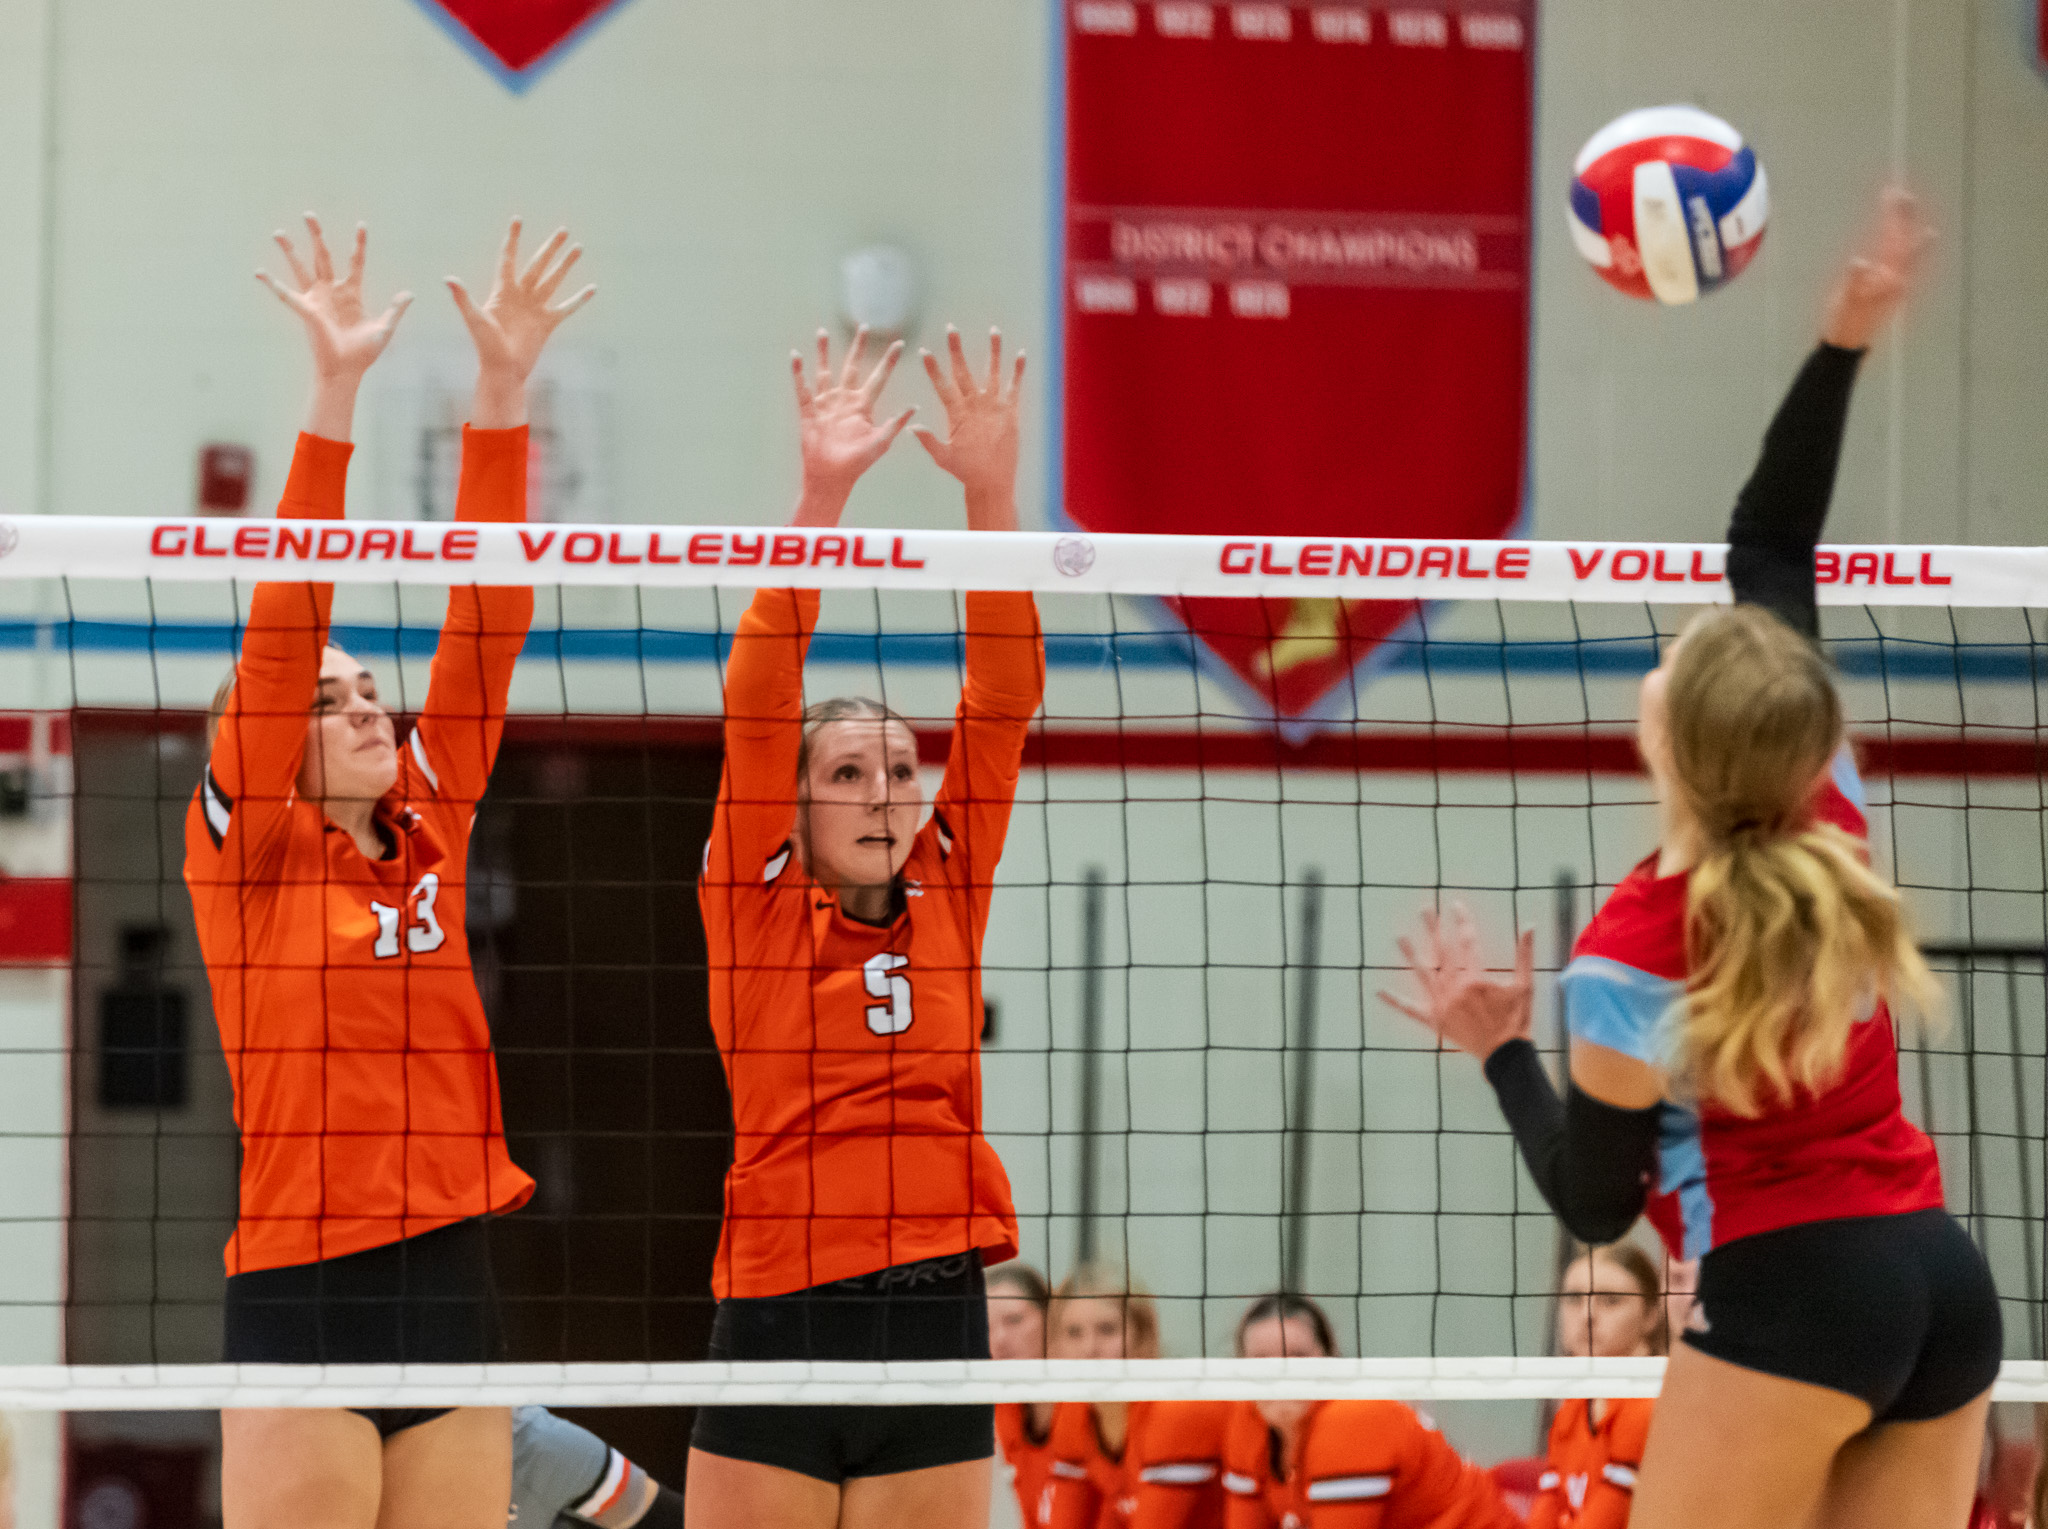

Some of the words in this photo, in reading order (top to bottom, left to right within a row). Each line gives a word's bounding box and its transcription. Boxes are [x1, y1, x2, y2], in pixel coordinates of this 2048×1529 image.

[1111, 220, 1254, 267] DISTRICT
[1257, 225, 1479, 273] CHAMPIONS
[150, 525, 478, 562] GLENDALE
[517, 530, 925, 569] VOLLEYBALL
[1219, 542, 1531, 580] GLENDALE
[1567, 548, 1952, 586] VOLLBALL
[370, 872, 447, 960] 13
[863, 952, 915, 1036] 5
[877, 1253, 969, 1290] PRO
